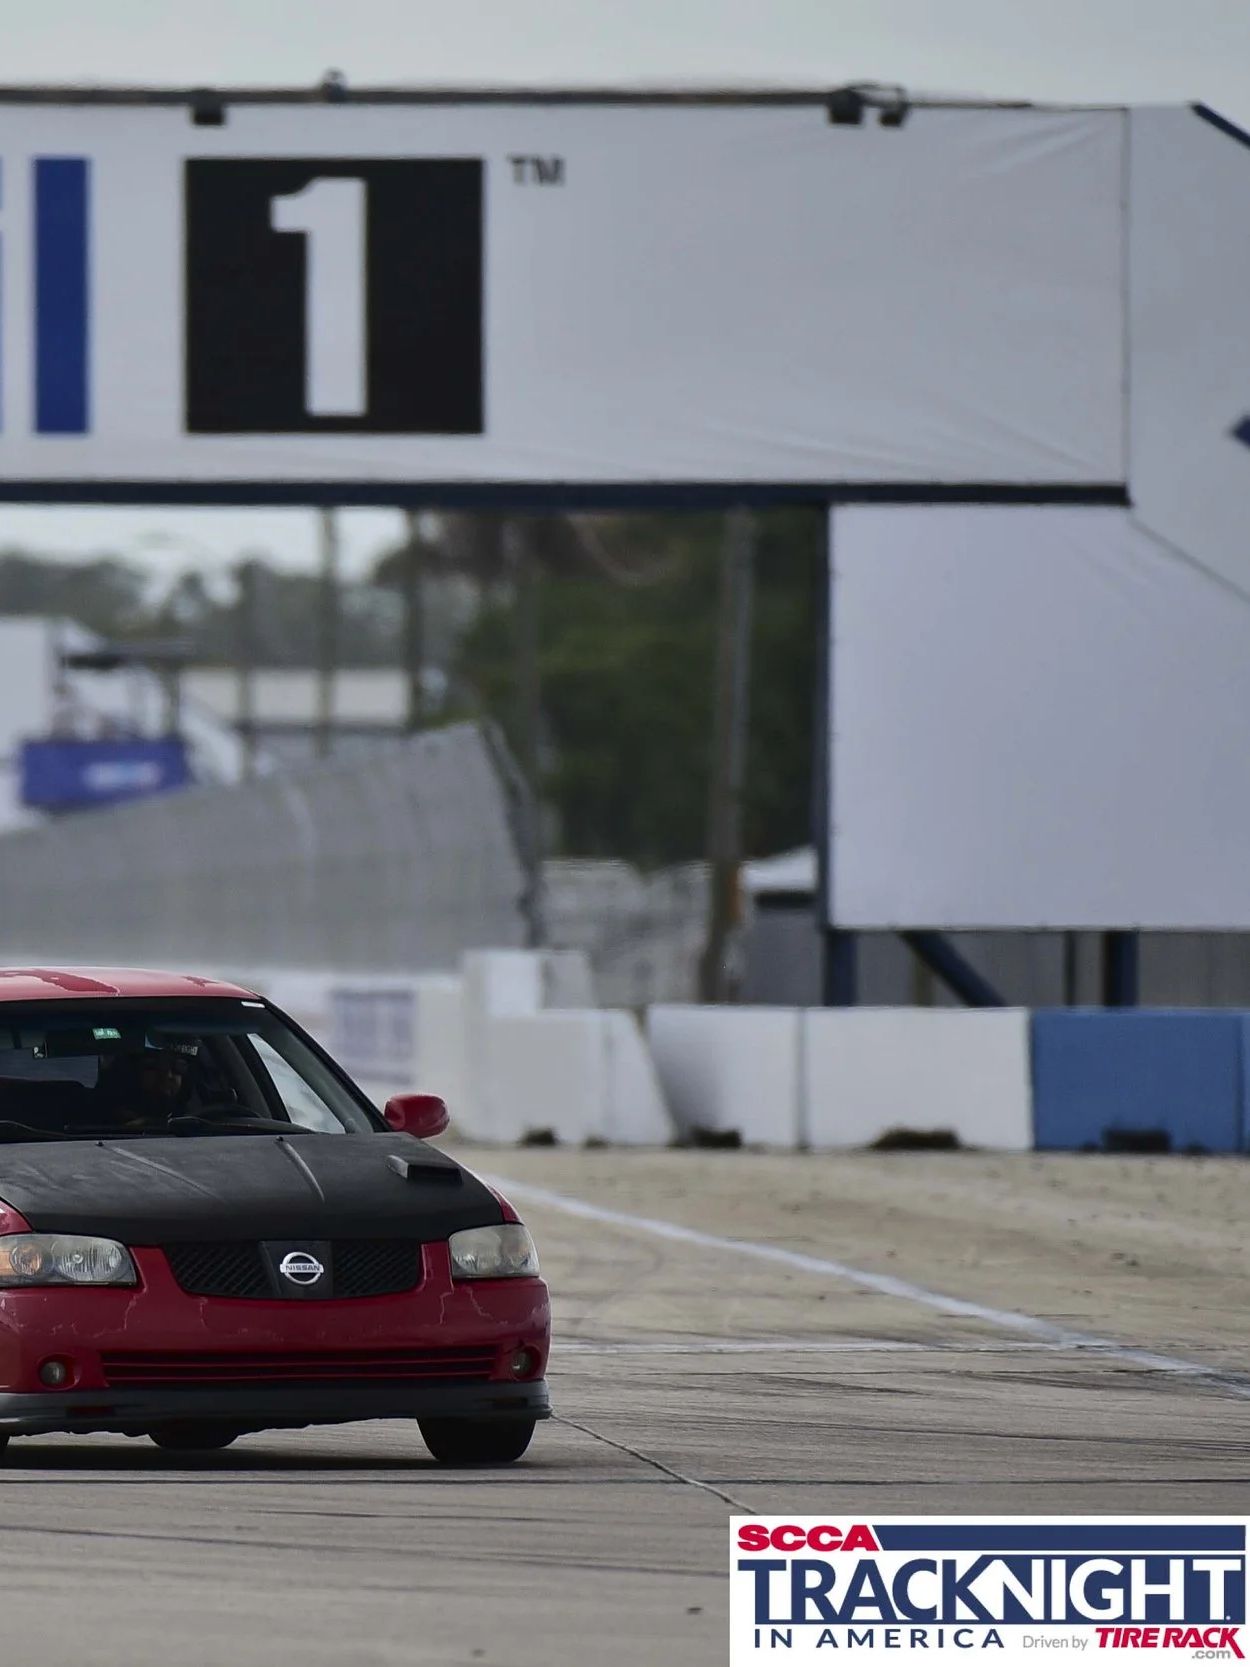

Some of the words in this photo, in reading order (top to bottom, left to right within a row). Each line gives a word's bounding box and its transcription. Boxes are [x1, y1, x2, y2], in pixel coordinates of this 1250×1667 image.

[270, 178, 367, 416] 1
[506, 155, 566, 186] TM
[285, 1263, 320, 1271] NISSAN
